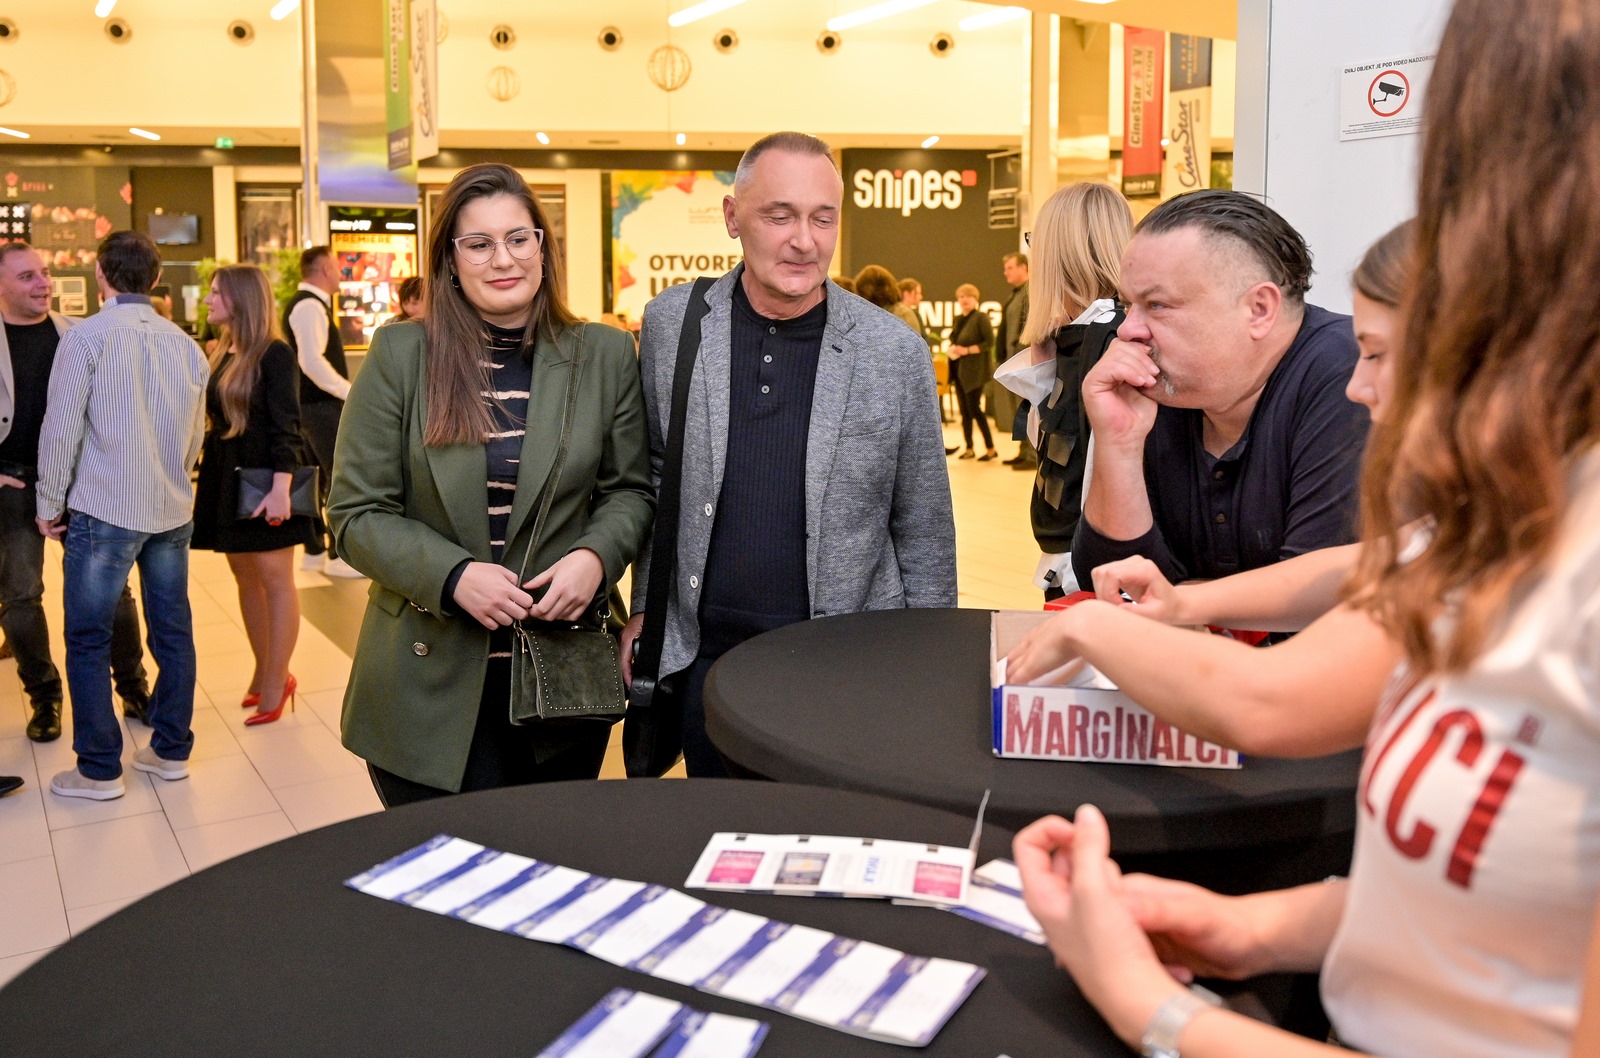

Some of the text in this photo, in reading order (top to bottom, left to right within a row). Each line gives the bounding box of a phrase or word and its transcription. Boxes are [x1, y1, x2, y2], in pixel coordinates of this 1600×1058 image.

[413, 12, 432, 137] CineStar
[1146, 50, 1154, 98] ACTION
[1357, 65, 1375, 73] OBJEKT
[1393, 59, 1407, 67] VIDEO
[1131, 49, 1143, 145] CineStar TV
[1172, 100, 1198, 188] CineStar
[853, 168, 963, 217] snipes
[649, 255, 744, 271] OTVORE
